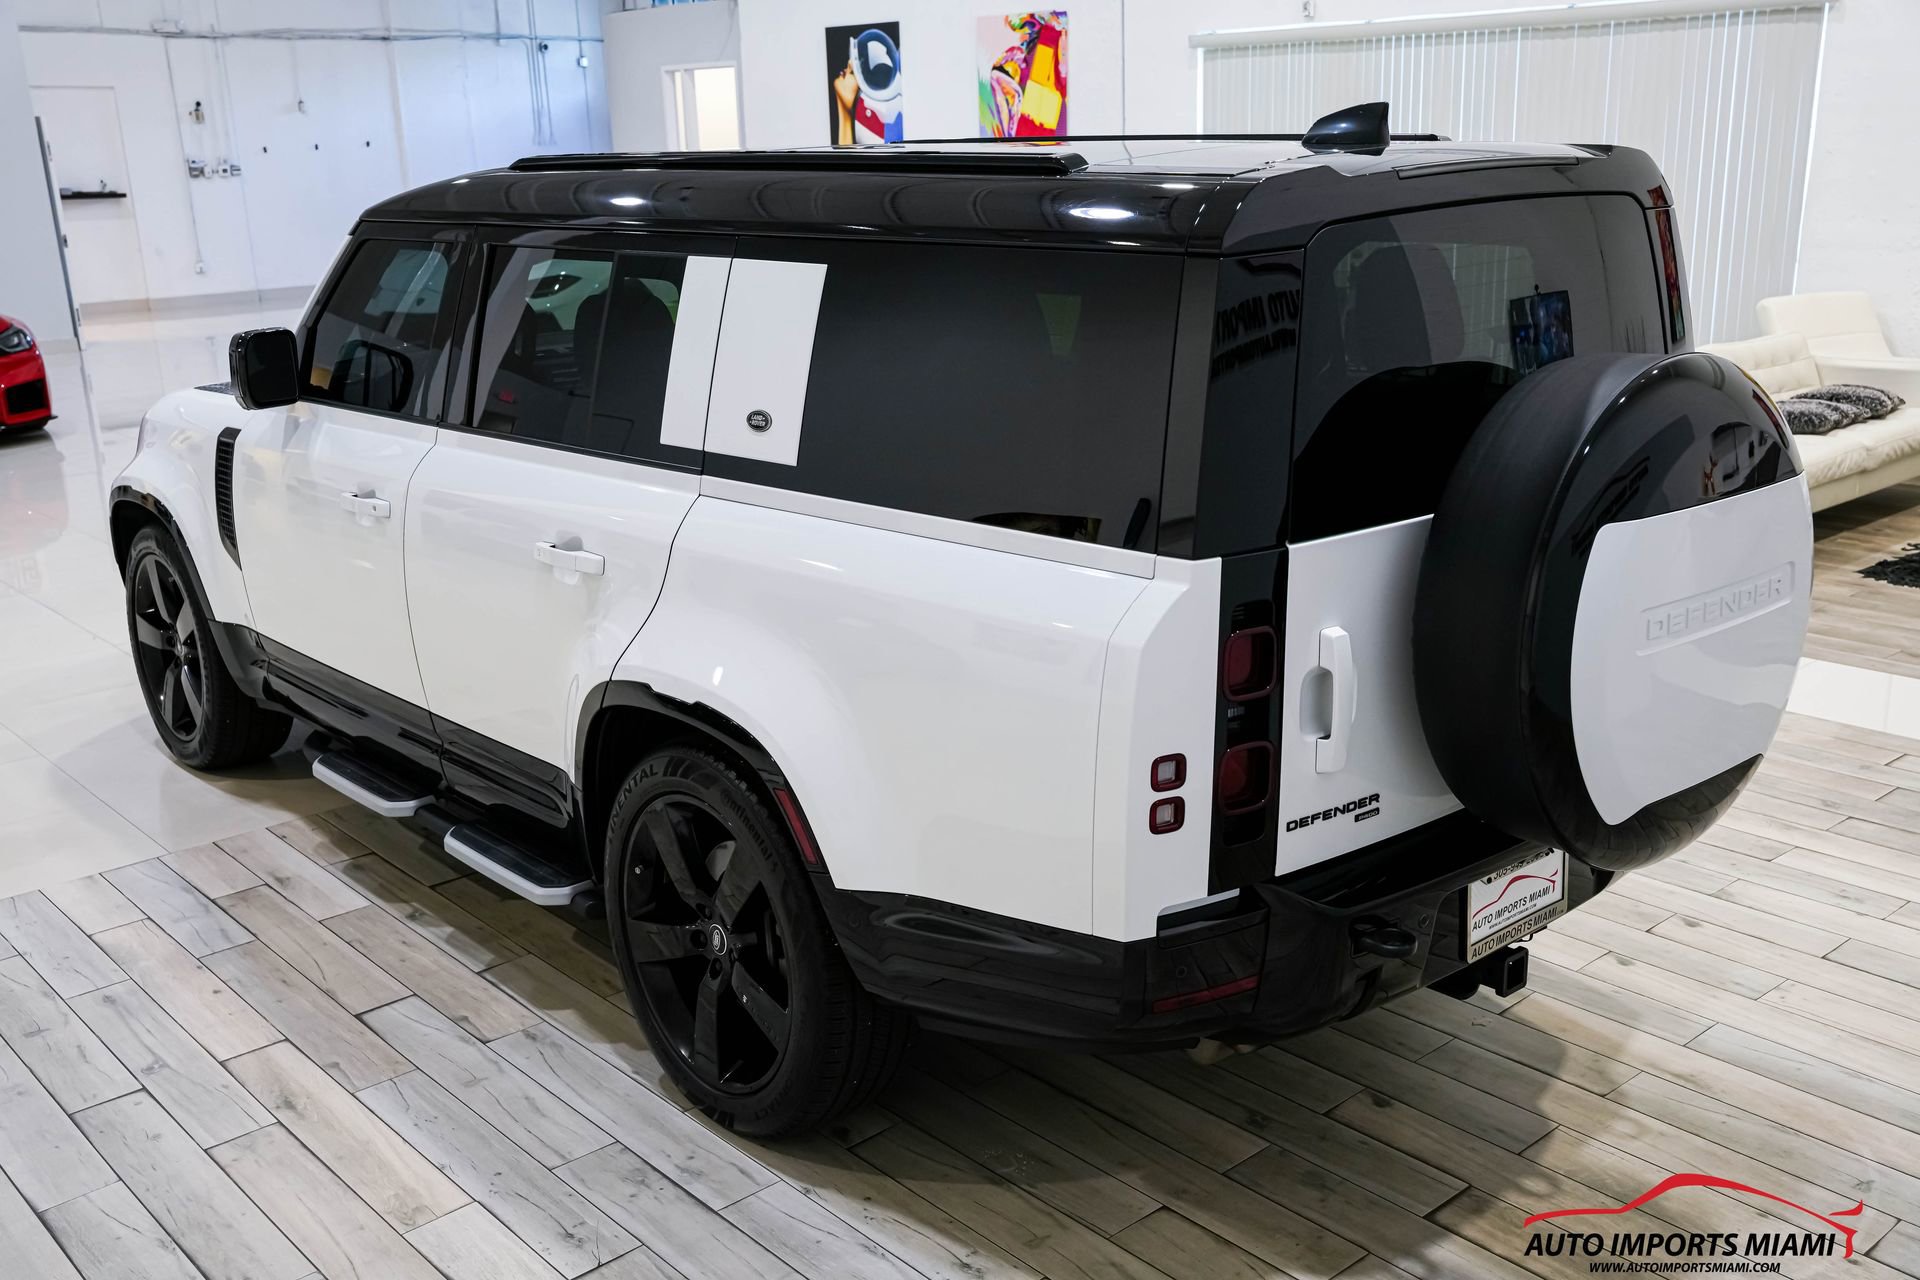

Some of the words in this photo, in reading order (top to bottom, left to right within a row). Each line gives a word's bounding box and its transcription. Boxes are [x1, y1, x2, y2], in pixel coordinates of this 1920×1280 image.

[1646, 575, 1783, 641] DEFENDER
[1286, 793, 1380, 832] DEFENDER
[1472, 914, 1494, 932] AUTO
[1494, 897, 1528, 921] IMPORTS
[1528, 885, 1551, 904] MIAMI
[1471, 939, 1495, 960] AUTO
[1495, 920, 1533, 947] IMPORTS
